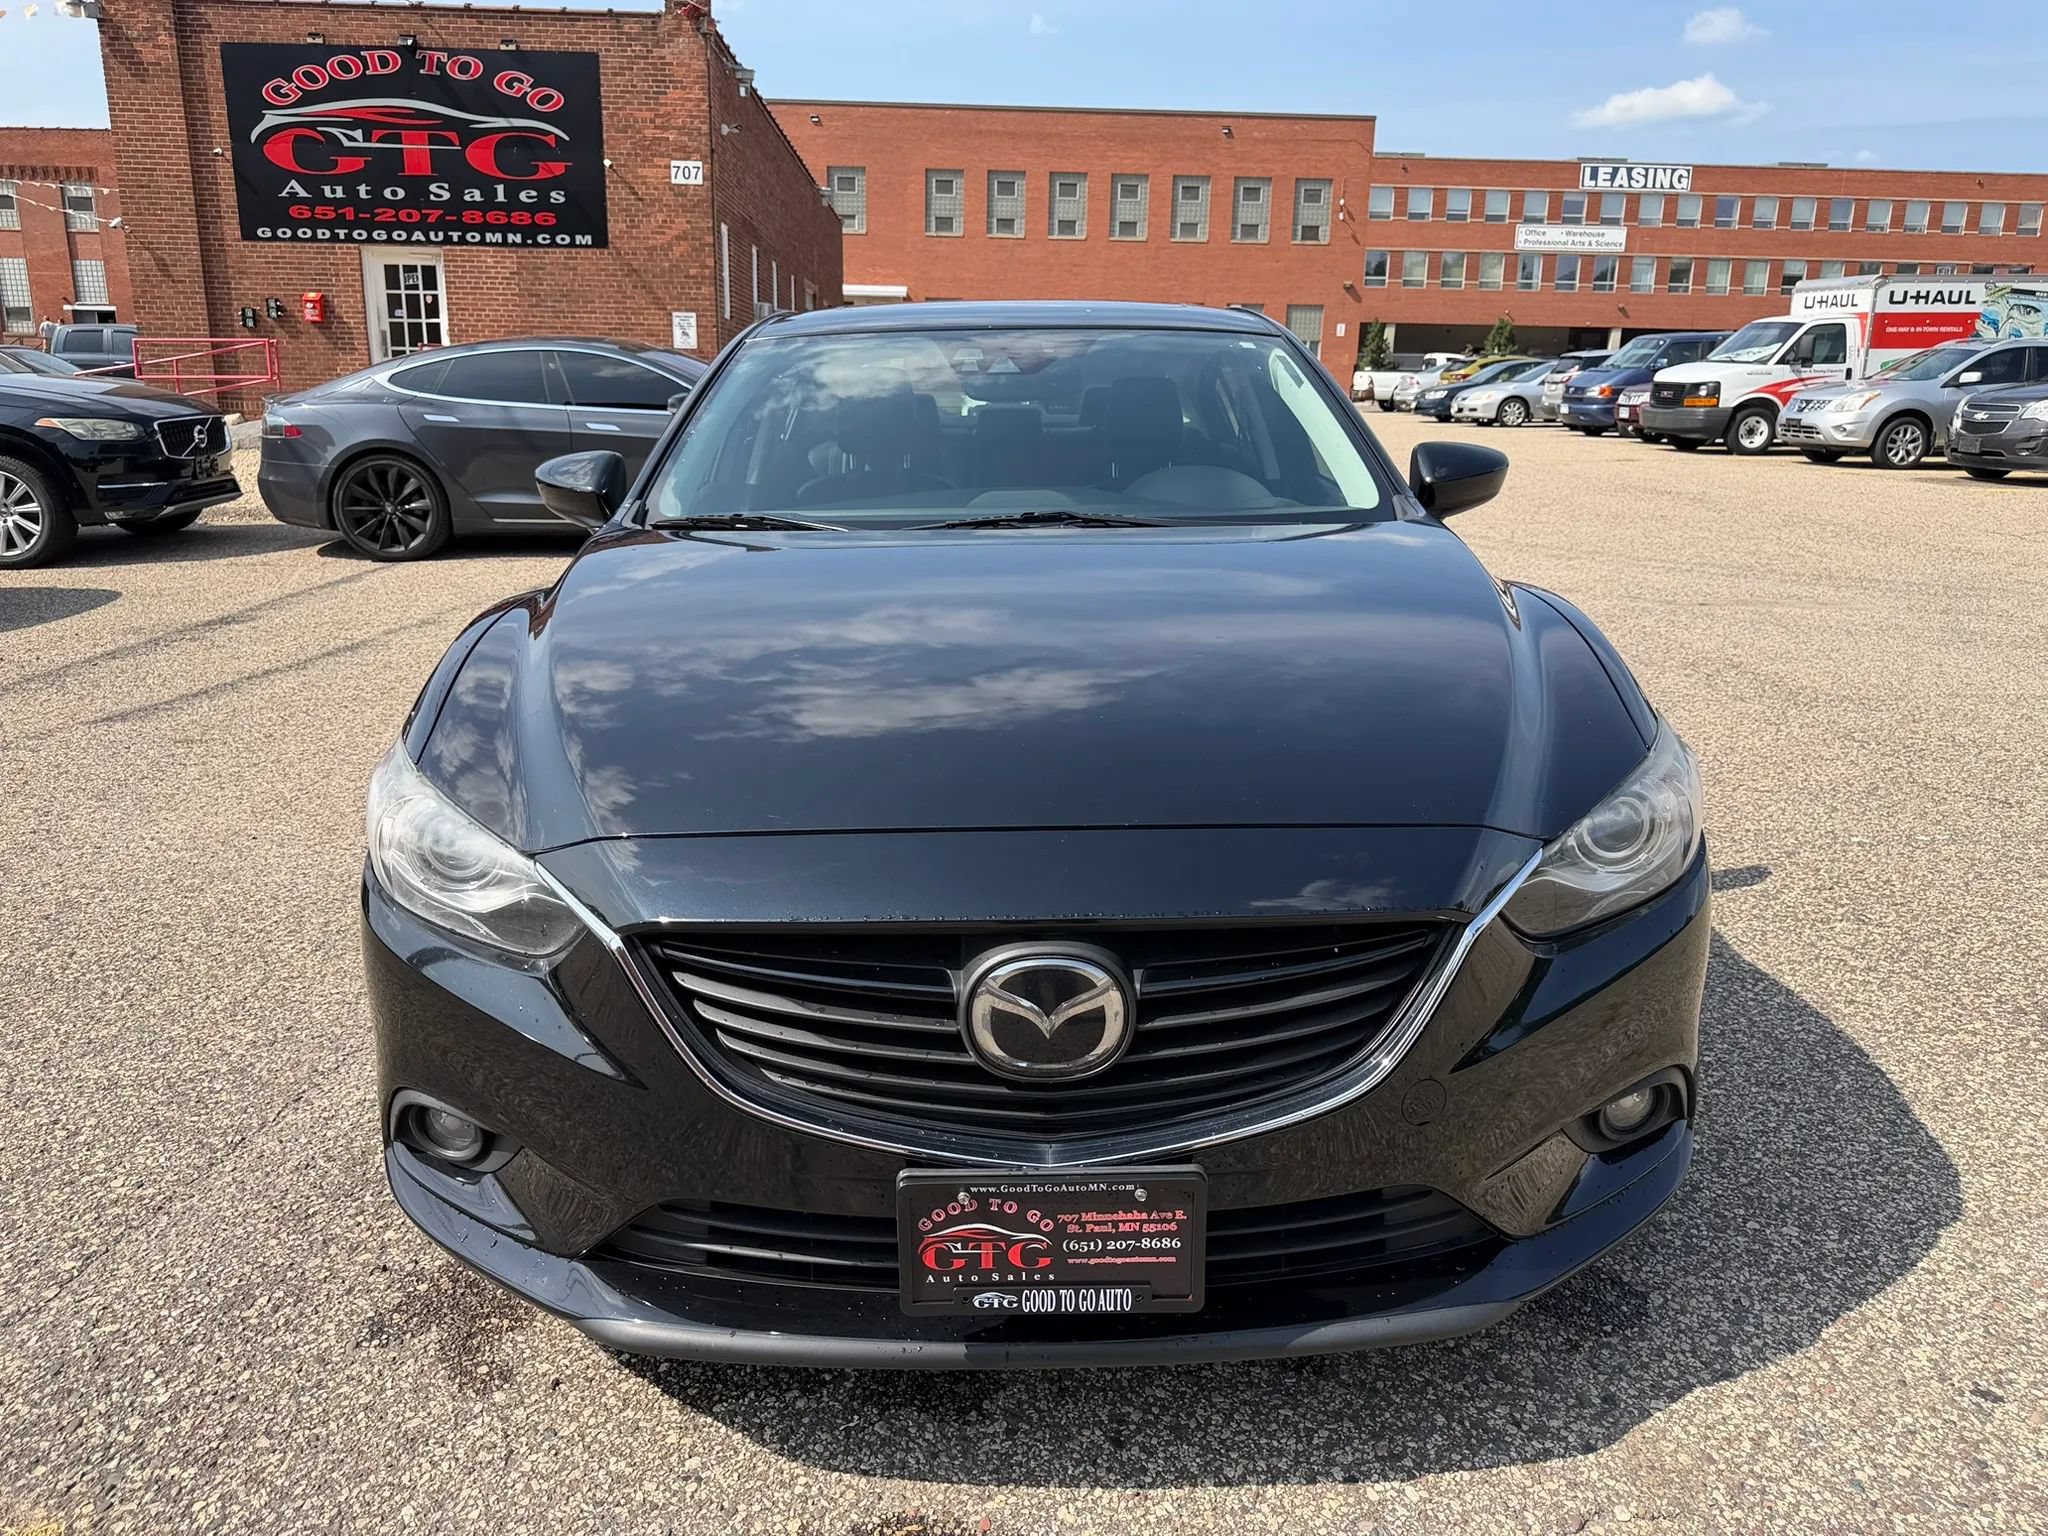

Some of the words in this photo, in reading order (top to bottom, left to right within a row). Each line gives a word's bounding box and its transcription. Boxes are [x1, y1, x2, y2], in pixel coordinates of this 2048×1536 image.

[262, 50, 401, 105] GOOD
[416, 50, 484, 80] TO
[493, 70, 565, 112] GO
[262, 127, 573, 181] GTG
[672, 166, 701, 180] 707
[1583, 166, 1689, 190] LEASING
[278, 178, 405, 201] Auto
[429, 183, 566, 203] Sales
[288, 205, 558, 226] 651-207-8686
[256, 227, 593, 246] GOODTOGOAUTOMN.COM
[1565, 230, 1606, 238] Warehouse
[1523, 238, 1569, 246] Professional
[1570, 239, 1585, 247] Arts
[1594, 240, 1623, 248] Science
[1804, 293, 1858, 309] U-HAUL
[1888, 289, 1976, 305] U-HAUL
[970, 1183, 1135, 1193] www.GoodToGoAutoMN.com
[918, 1199, 978, 1231] GOOD
[989, 1198, 1018, 1214] TO
[1026, 1209, 1054, 1232] GO
[1057, 1214, 1079, 1223] 707
[1150, 1210, 1173, 1220] Ave
[1174, 1210, 1187, 1219] E.
[1066, 1224, 1083, 1233] St.
[1085, 1223, 1116, 1233] Paul,
[1118, 1222, 1140, 1232] MN
[1142, 1221, 1178, 1233] 55106
[1062, 1238, 1102, 1252] (651)
[1106, 1237, 1181, 1251] 207-8686
[922, 1241, 1054, 1271] GTG
[926, 1272, 978, 1283] Auto
[992, 1272, 1054, 1282] Sales
[1022, 1289, 1056, 1312] GOOD
[1059, 1289, 1075, 1312] TO
[1079, 1289, 1096, 1312] GO
[1097, 1288, 1132, 1312] AUTO
